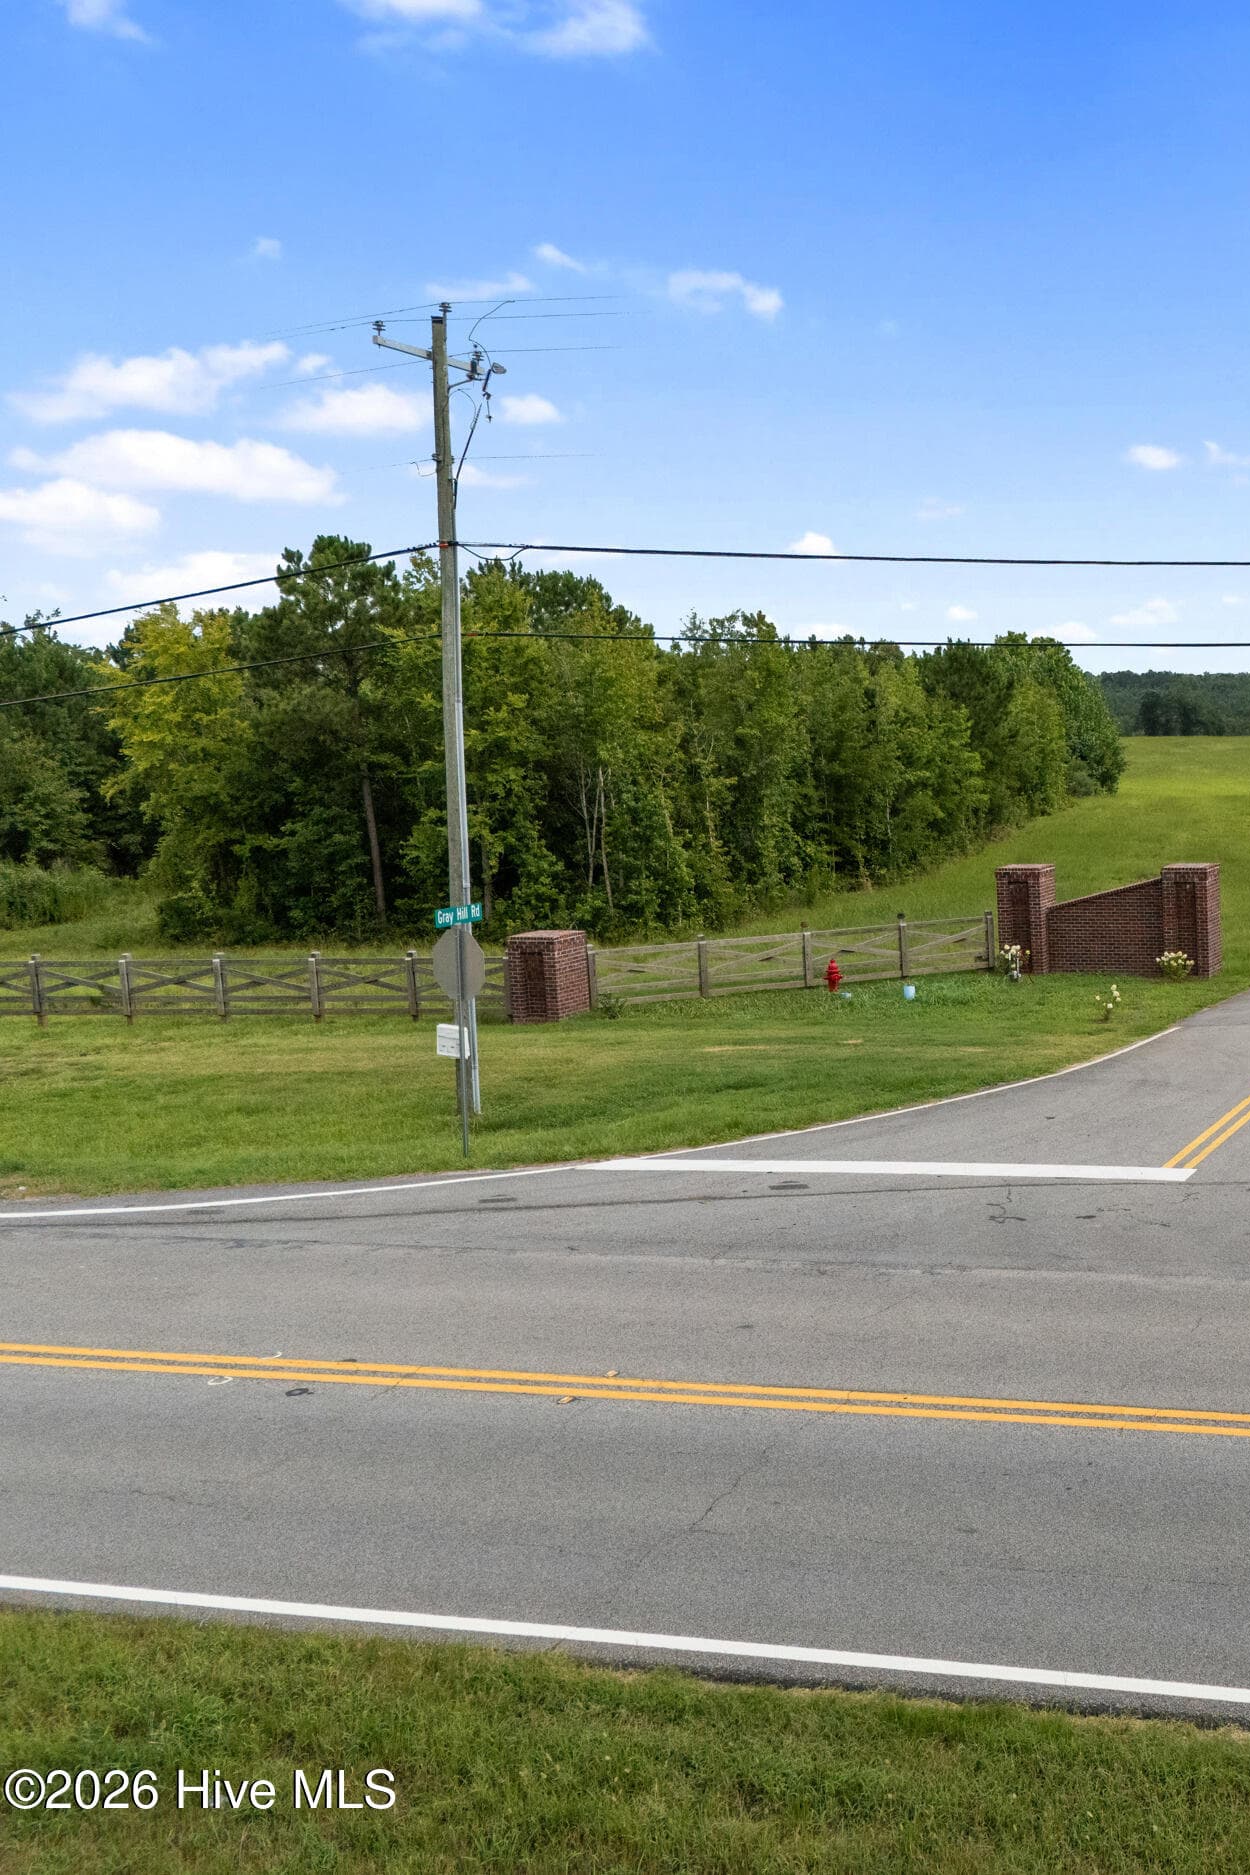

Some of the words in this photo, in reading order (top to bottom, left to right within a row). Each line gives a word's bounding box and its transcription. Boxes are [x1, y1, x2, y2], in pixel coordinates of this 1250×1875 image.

[438, 910, 453, 925] Gray
[456, 906, 468, 920] Hill
[471, 904, 480, 917] Rd
